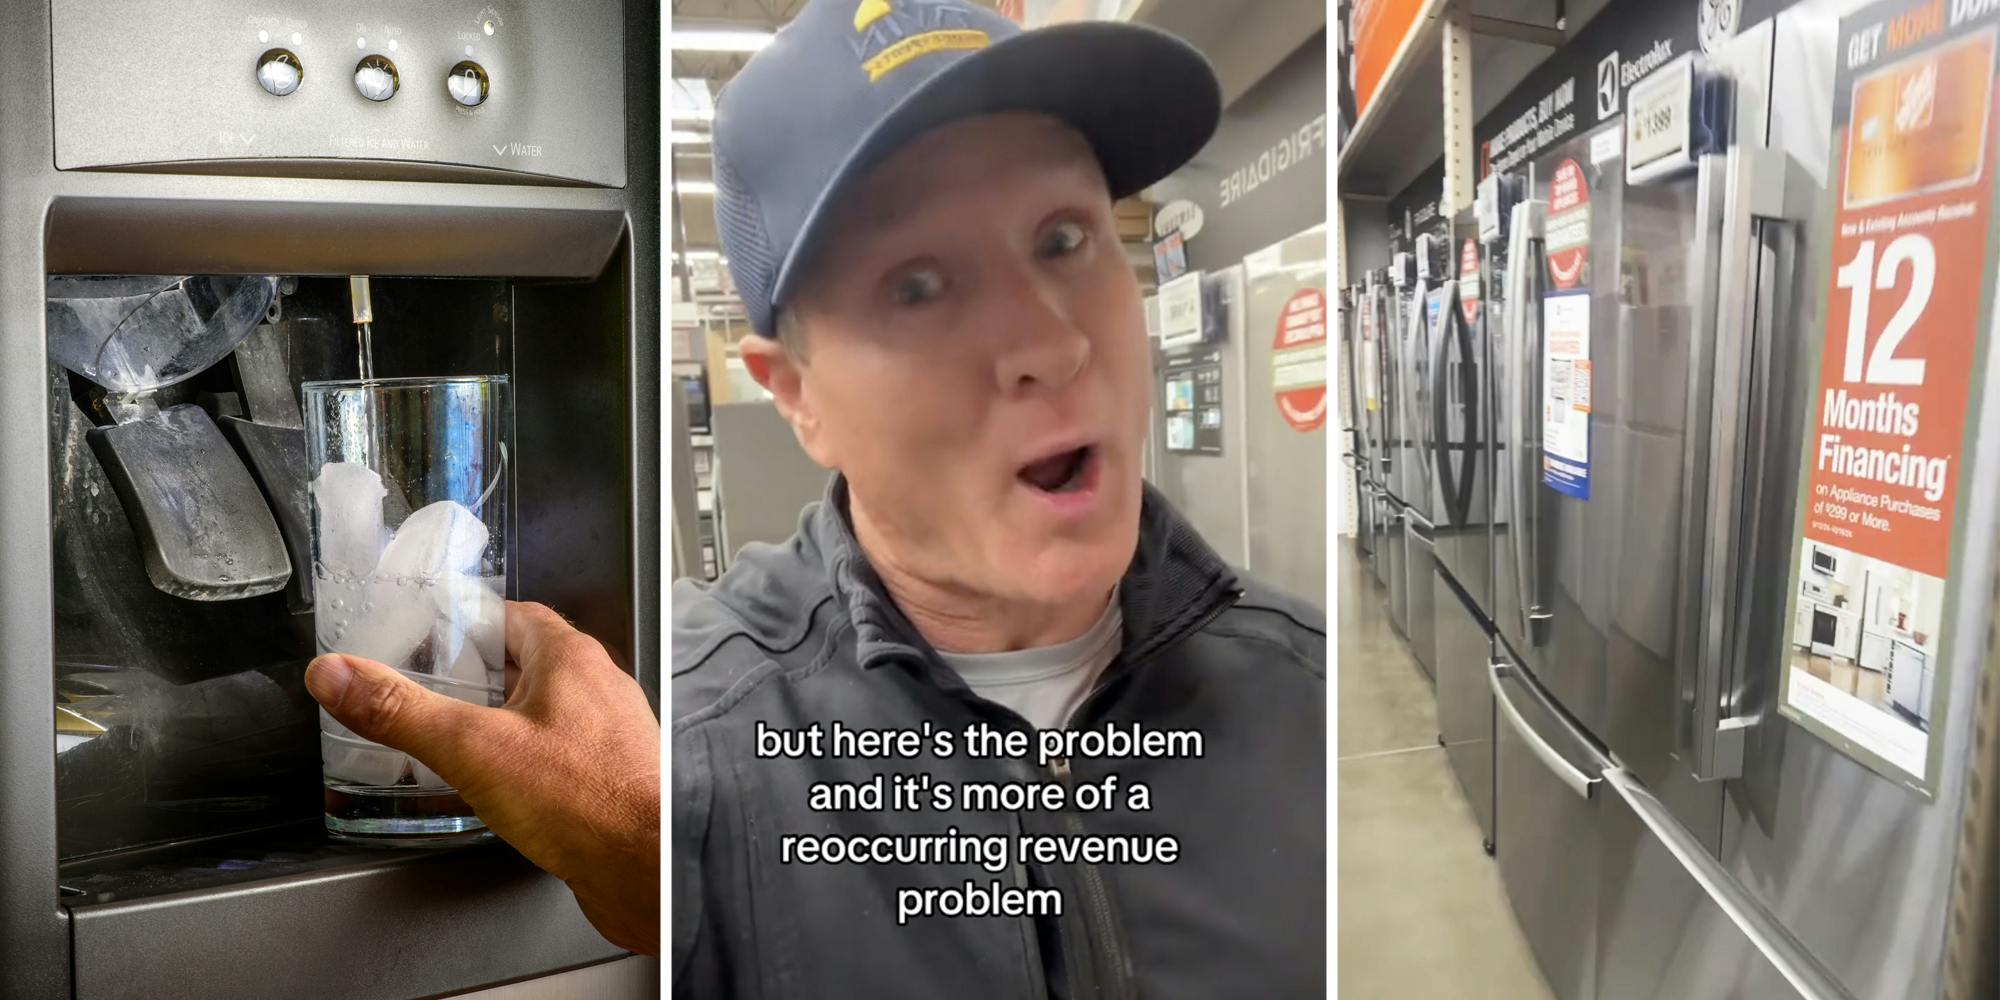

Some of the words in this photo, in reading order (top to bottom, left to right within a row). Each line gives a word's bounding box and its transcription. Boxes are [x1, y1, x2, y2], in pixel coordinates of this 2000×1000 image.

[1837, 233, 1936, 385] 12
[1823, 388, 1920, 437] Months
[1813, 501, 1824, 514] of
[1825, 503, 1848, 520] $299
[1848, 511, 1859, 523] or
[1862, 511, 1892, 532] More.
[1815, 483, 1828, 496] on
[1829, 484, 1879, 508] Appliance
[1880, 494, 1942, 521] Purchases
